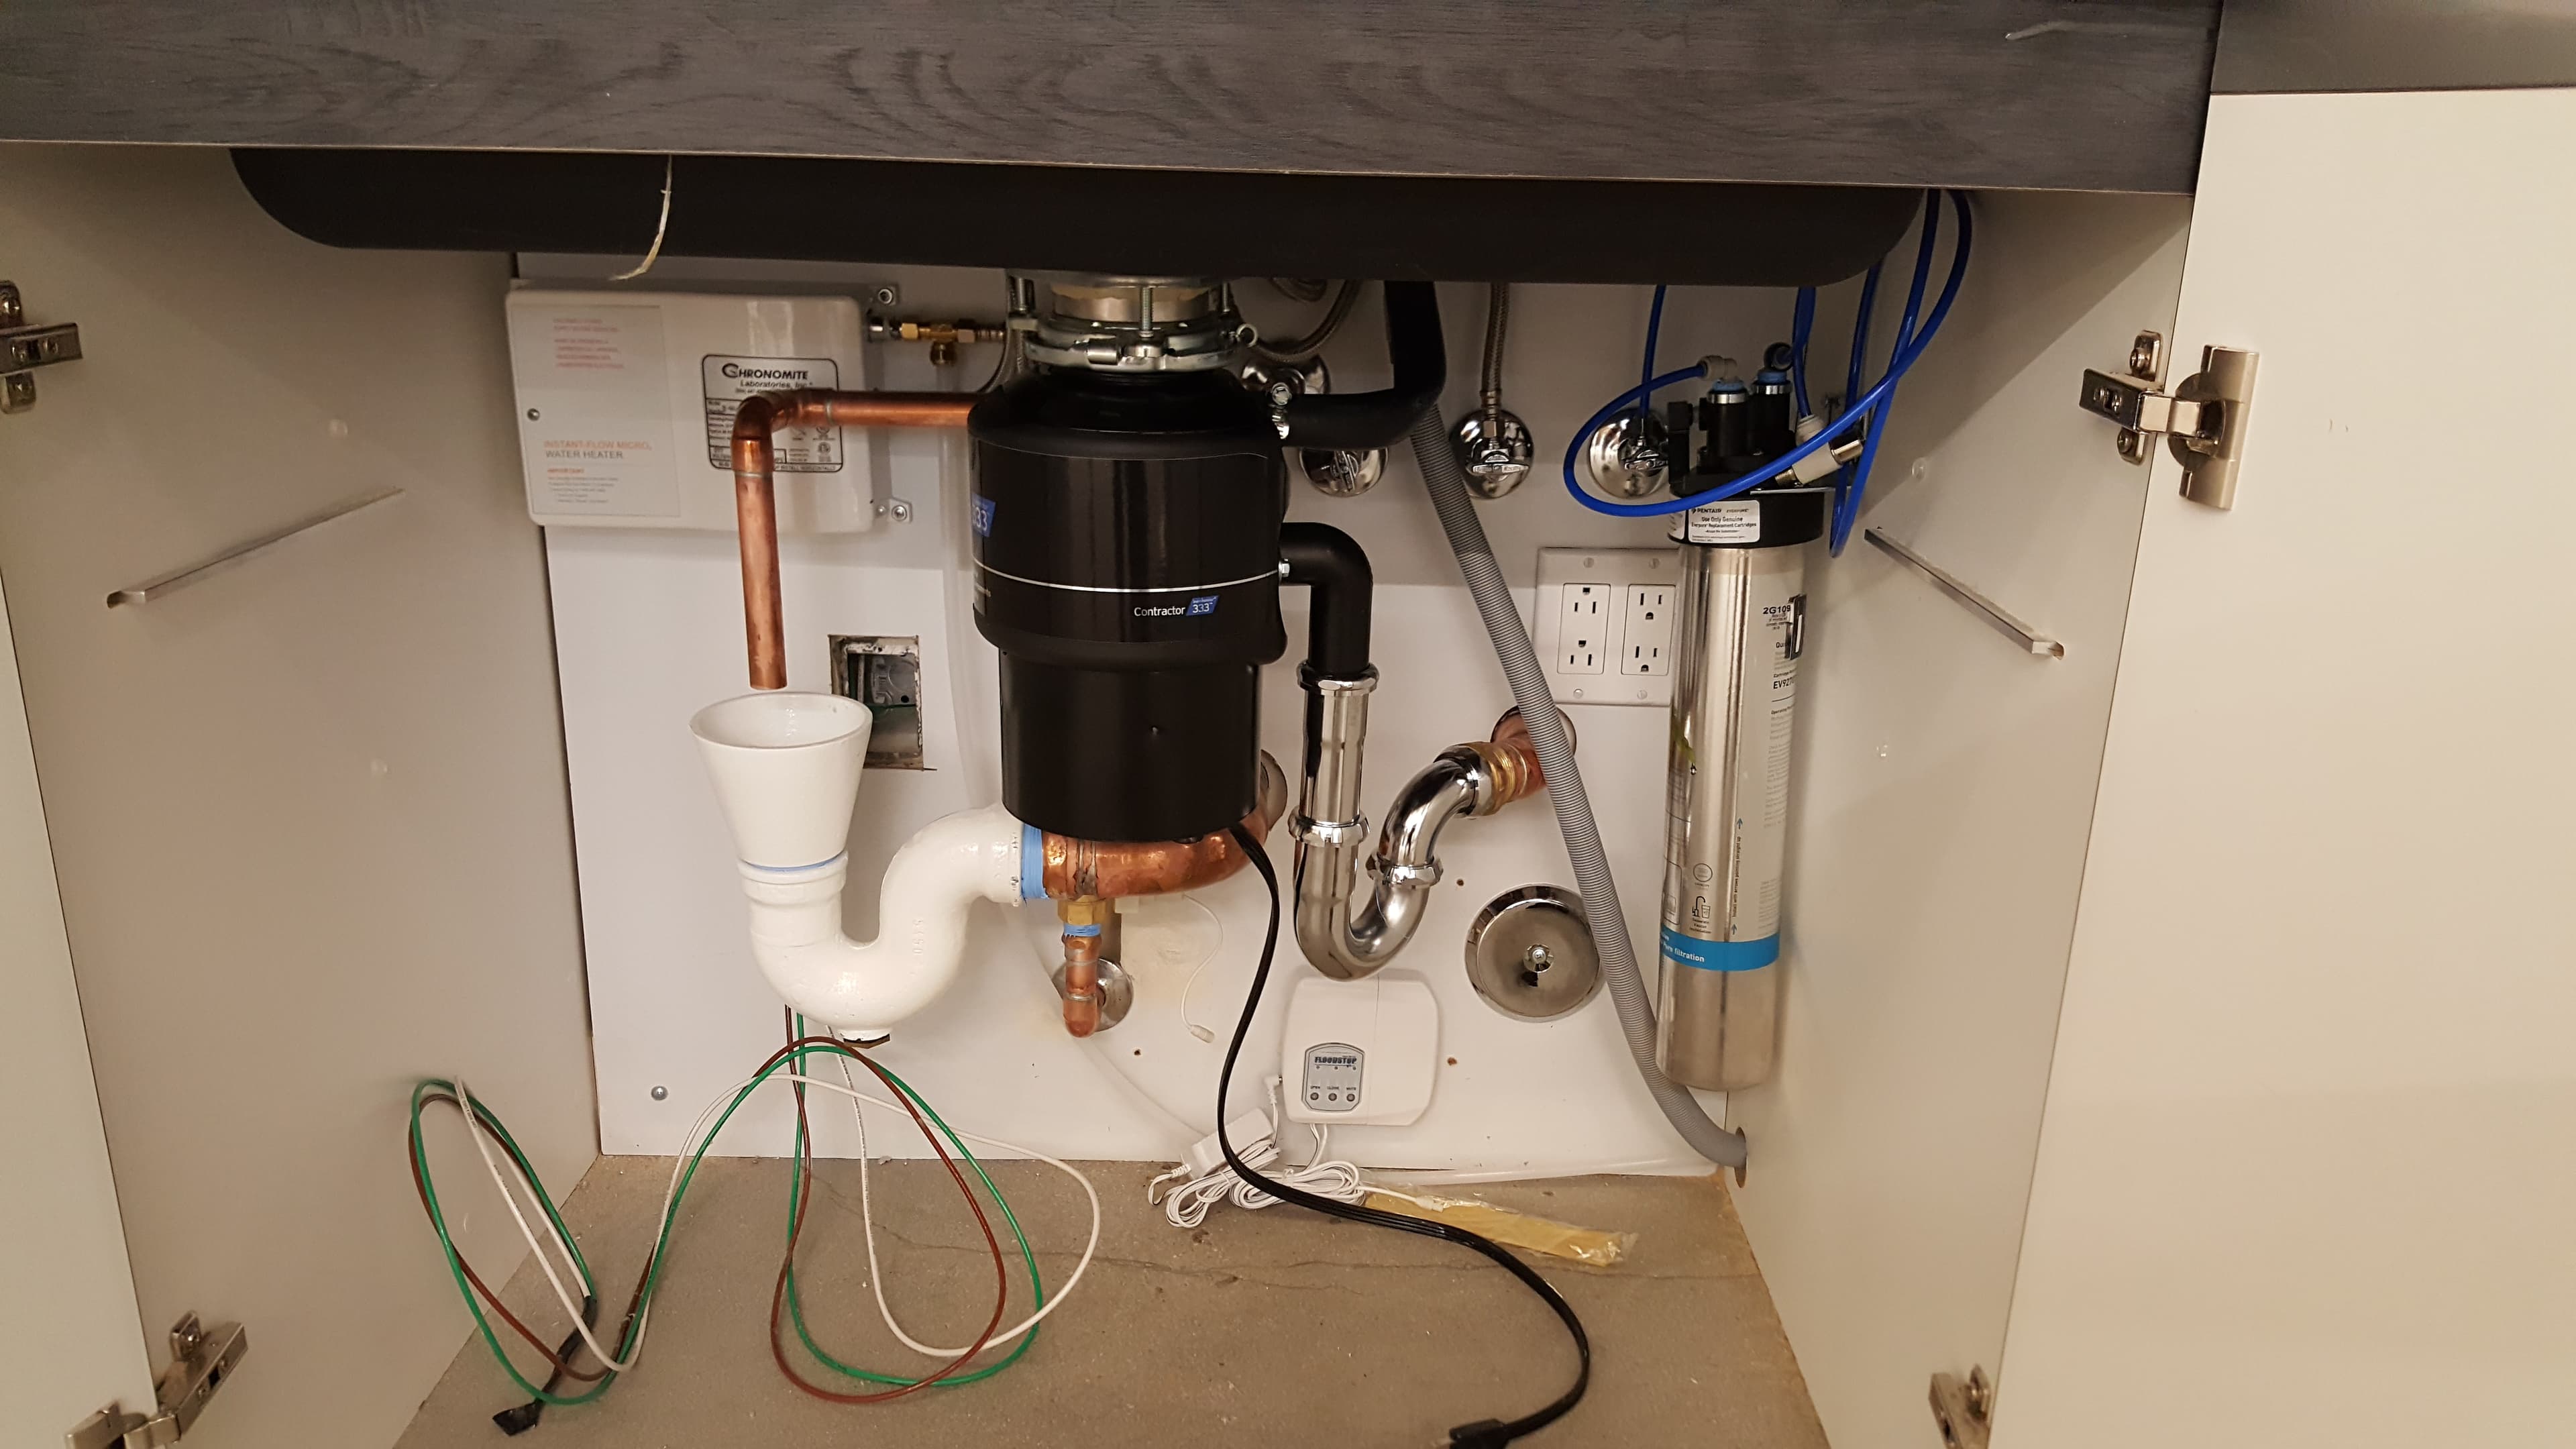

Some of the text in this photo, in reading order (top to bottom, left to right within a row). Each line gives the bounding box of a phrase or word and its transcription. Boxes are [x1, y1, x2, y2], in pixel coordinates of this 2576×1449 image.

[722, 363, 809, 380] CHRONOMITE
[545, 450, 623, 460] WATER HEATER
[1134, 606, 1186, 616] Contractor
[1763, 605, 1791, 614] 2G109
[1674, 948, 1705, 963] filtration
